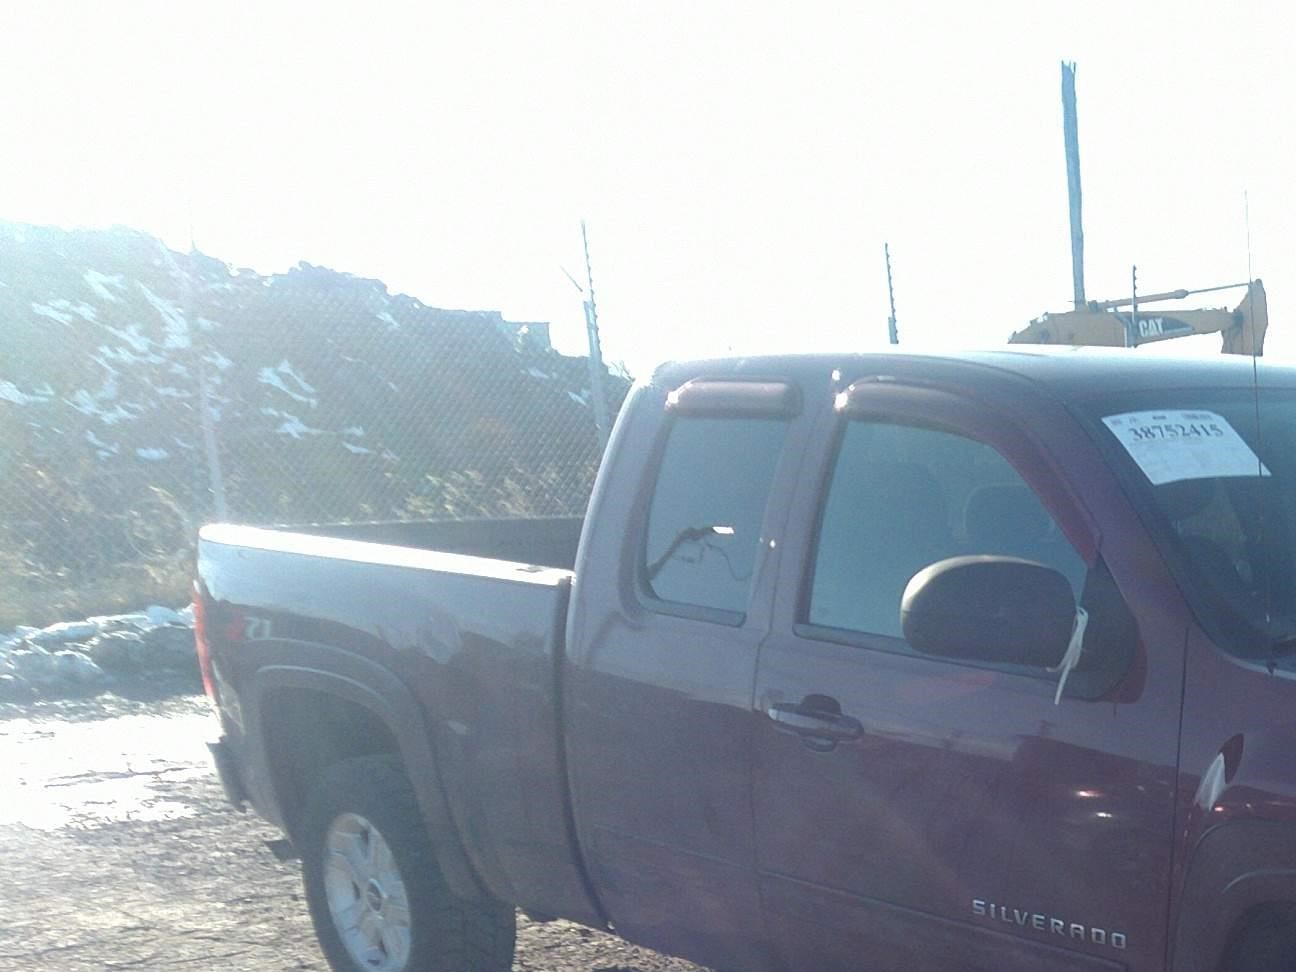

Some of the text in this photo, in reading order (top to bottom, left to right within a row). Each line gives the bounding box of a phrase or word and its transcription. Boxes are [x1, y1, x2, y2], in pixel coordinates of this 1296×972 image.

[1138, 318, 1164, 337] CAT
[1128, 422, 1224, 441] 38752415
[972, 899, 1127, 950] SILVERADO
